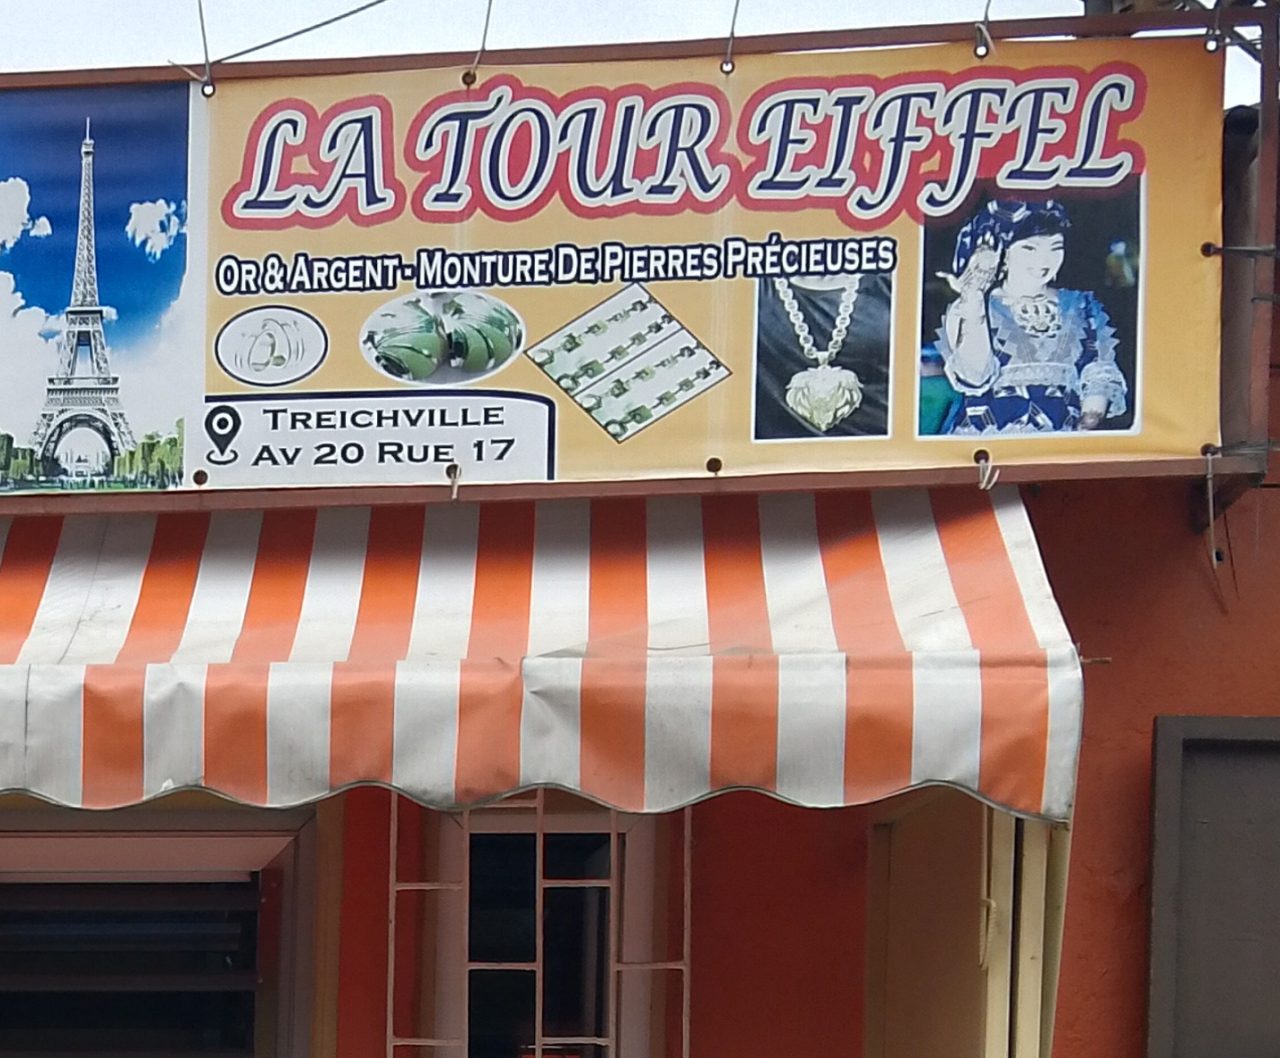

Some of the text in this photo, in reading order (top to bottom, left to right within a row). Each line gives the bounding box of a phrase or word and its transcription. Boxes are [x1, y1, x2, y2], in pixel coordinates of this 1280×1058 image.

[234, 105, 394, 217] LA
[418, 85, 729, 211] TOUR
[748, 74, 1134, 216] EIFFEL
[218, 258, 257, 293] OR
[263, 257, 285, 290] &
[557, 246, 599, 280] DE
[603, 244, 719, 279] PIERRES
[726, 236, 895, 276] PRÉCIEUSES
[262, 406, 505, 431] TREICHVILLE
[251, 438, 516, 466] AV 20 RUE 17
